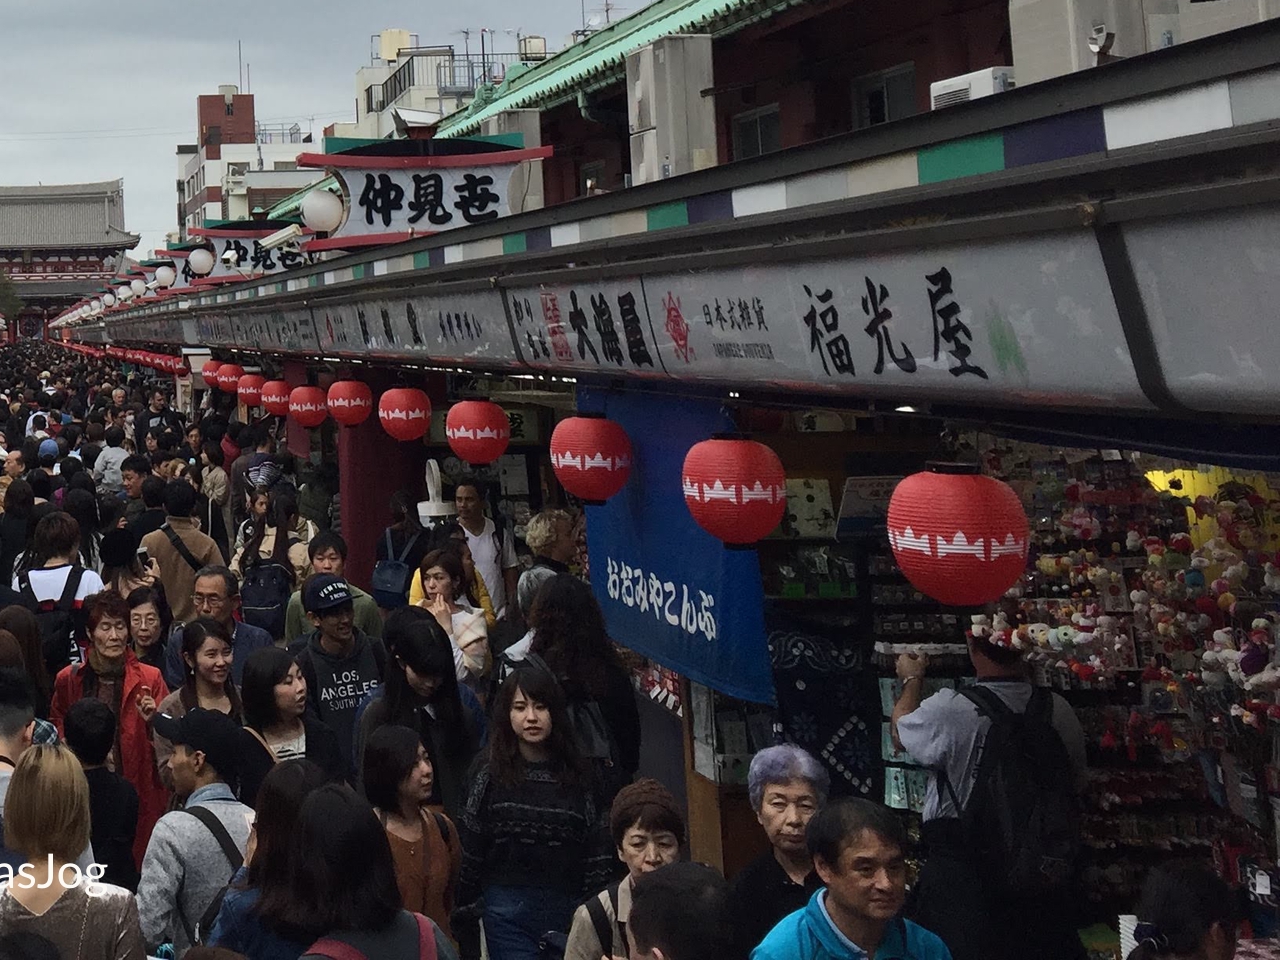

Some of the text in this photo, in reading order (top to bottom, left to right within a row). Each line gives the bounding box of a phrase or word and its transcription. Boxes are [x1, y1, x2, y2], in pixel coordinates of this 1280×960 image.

[358, 172, 501, 227] 仲見世
[802, 266, 990, 380] 福光屋
[320, 679, 379, 701] ANGELES
[332, 669, 360, 685] LOS
